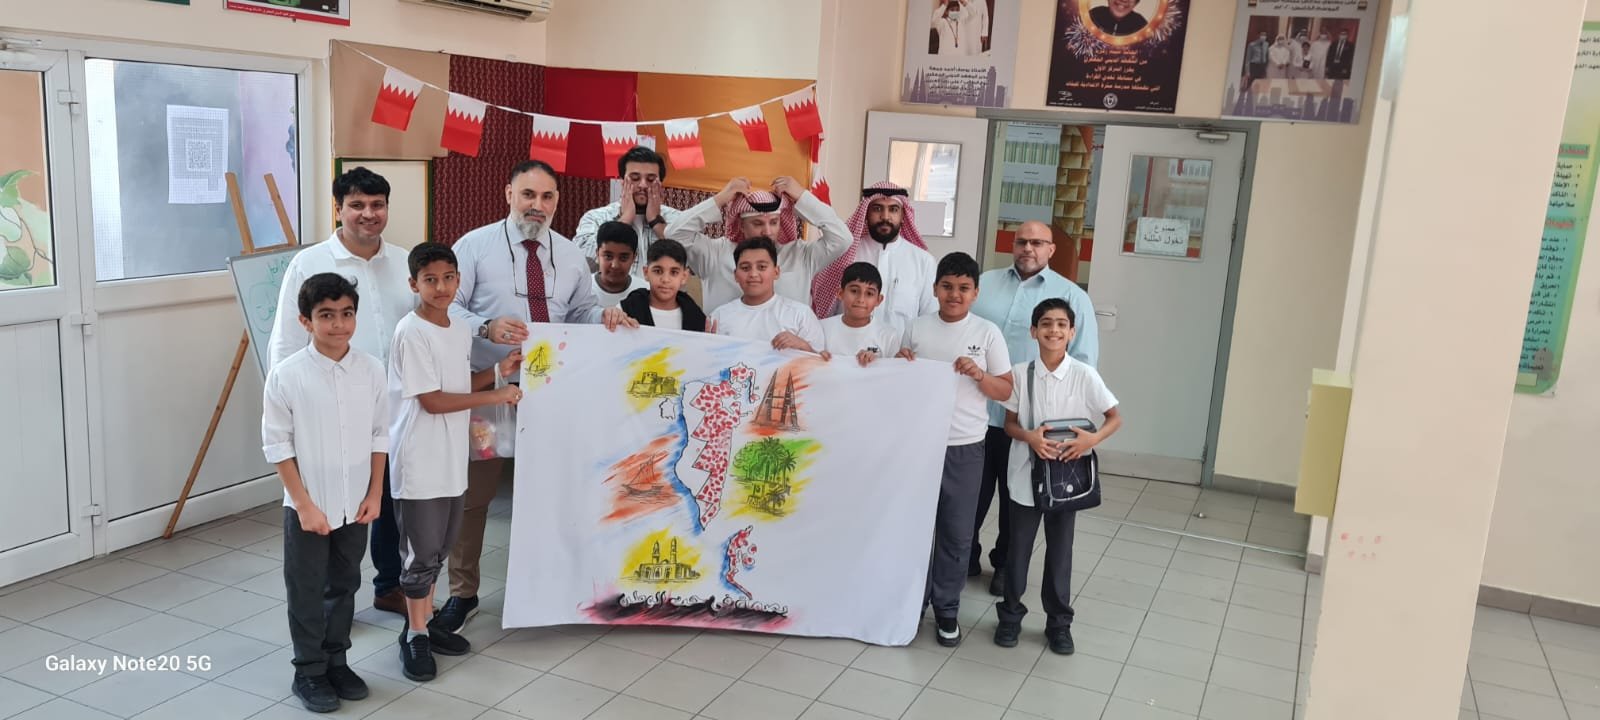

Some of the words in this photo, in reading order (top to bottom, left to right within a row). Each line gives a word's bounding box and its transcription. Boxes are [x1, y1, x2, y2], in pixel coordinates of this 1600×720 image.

[1153, 224, 1176, 234] ممنوع
[1143, 232, 1162, 243] الطلبة
[1163, 235, 1184, 246] دخول
[618, 590, 666, 609] الوطن
[709, 593, 735, 613] في
